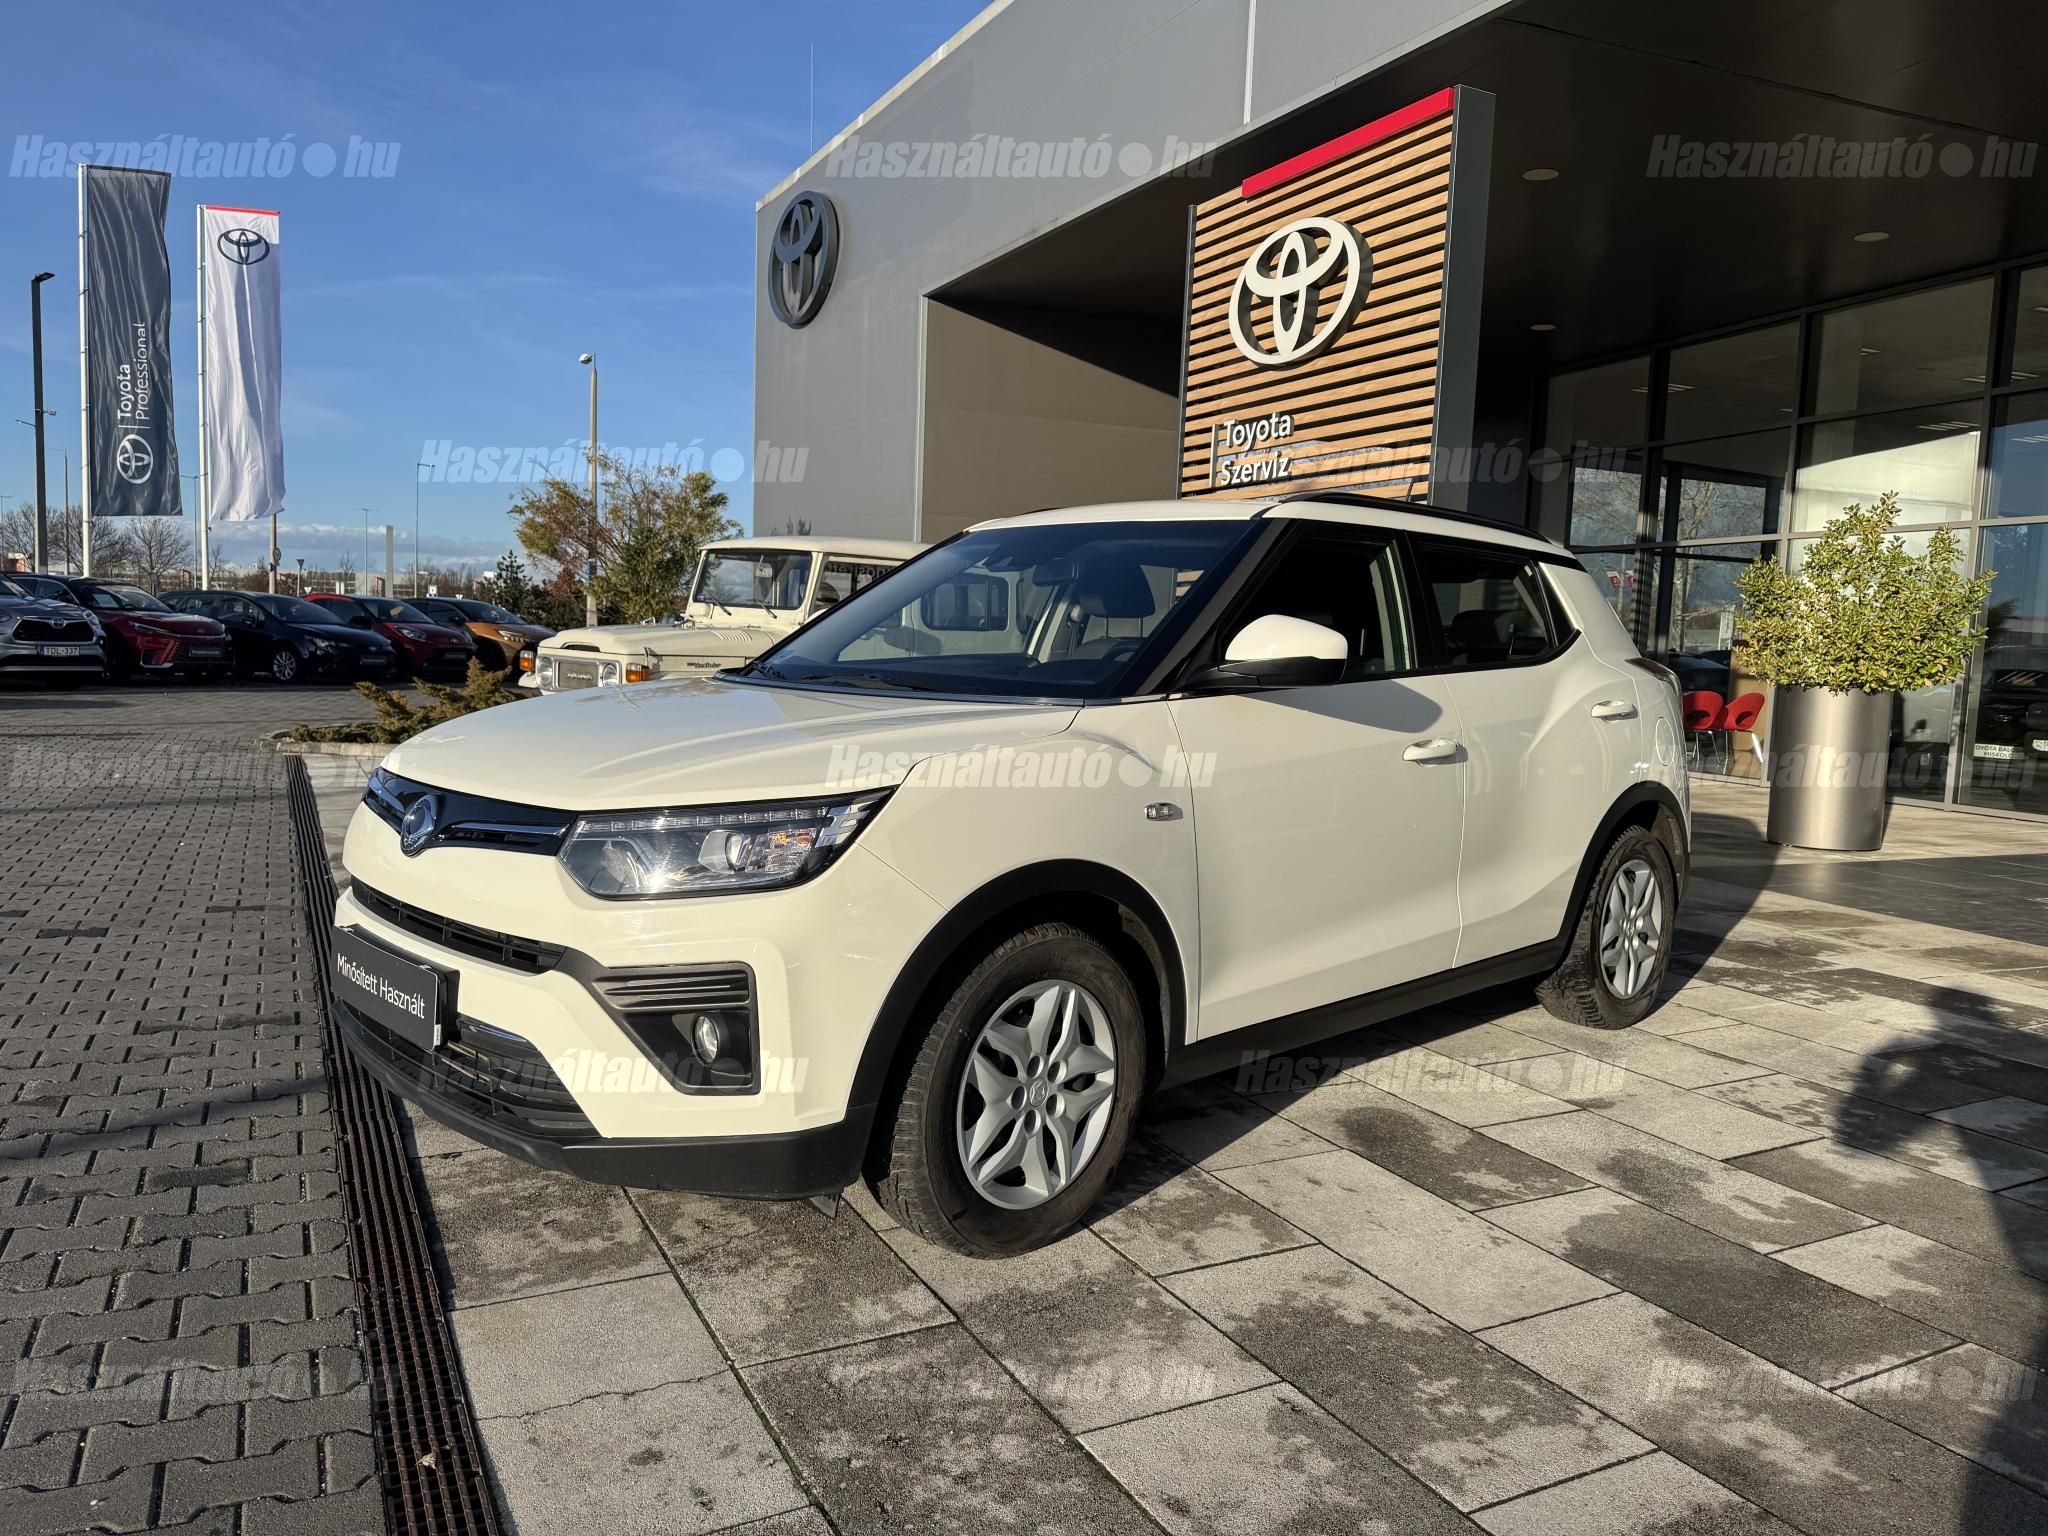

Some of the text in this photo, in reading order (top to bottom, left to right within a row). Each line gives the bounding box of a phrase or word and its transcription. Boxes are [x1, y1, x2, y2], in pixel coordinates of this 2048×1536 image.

[117, 363, 135, 419] Toyota
[133, 322, 149, 419] Professional
[1223, 411, 1292, 450] Toyota
[1220, 450, 1290, 486] Szerviz
[1975, 744, 1998, 752] OYOTA
[337, 952, 425, 1019] Minősített Használt
